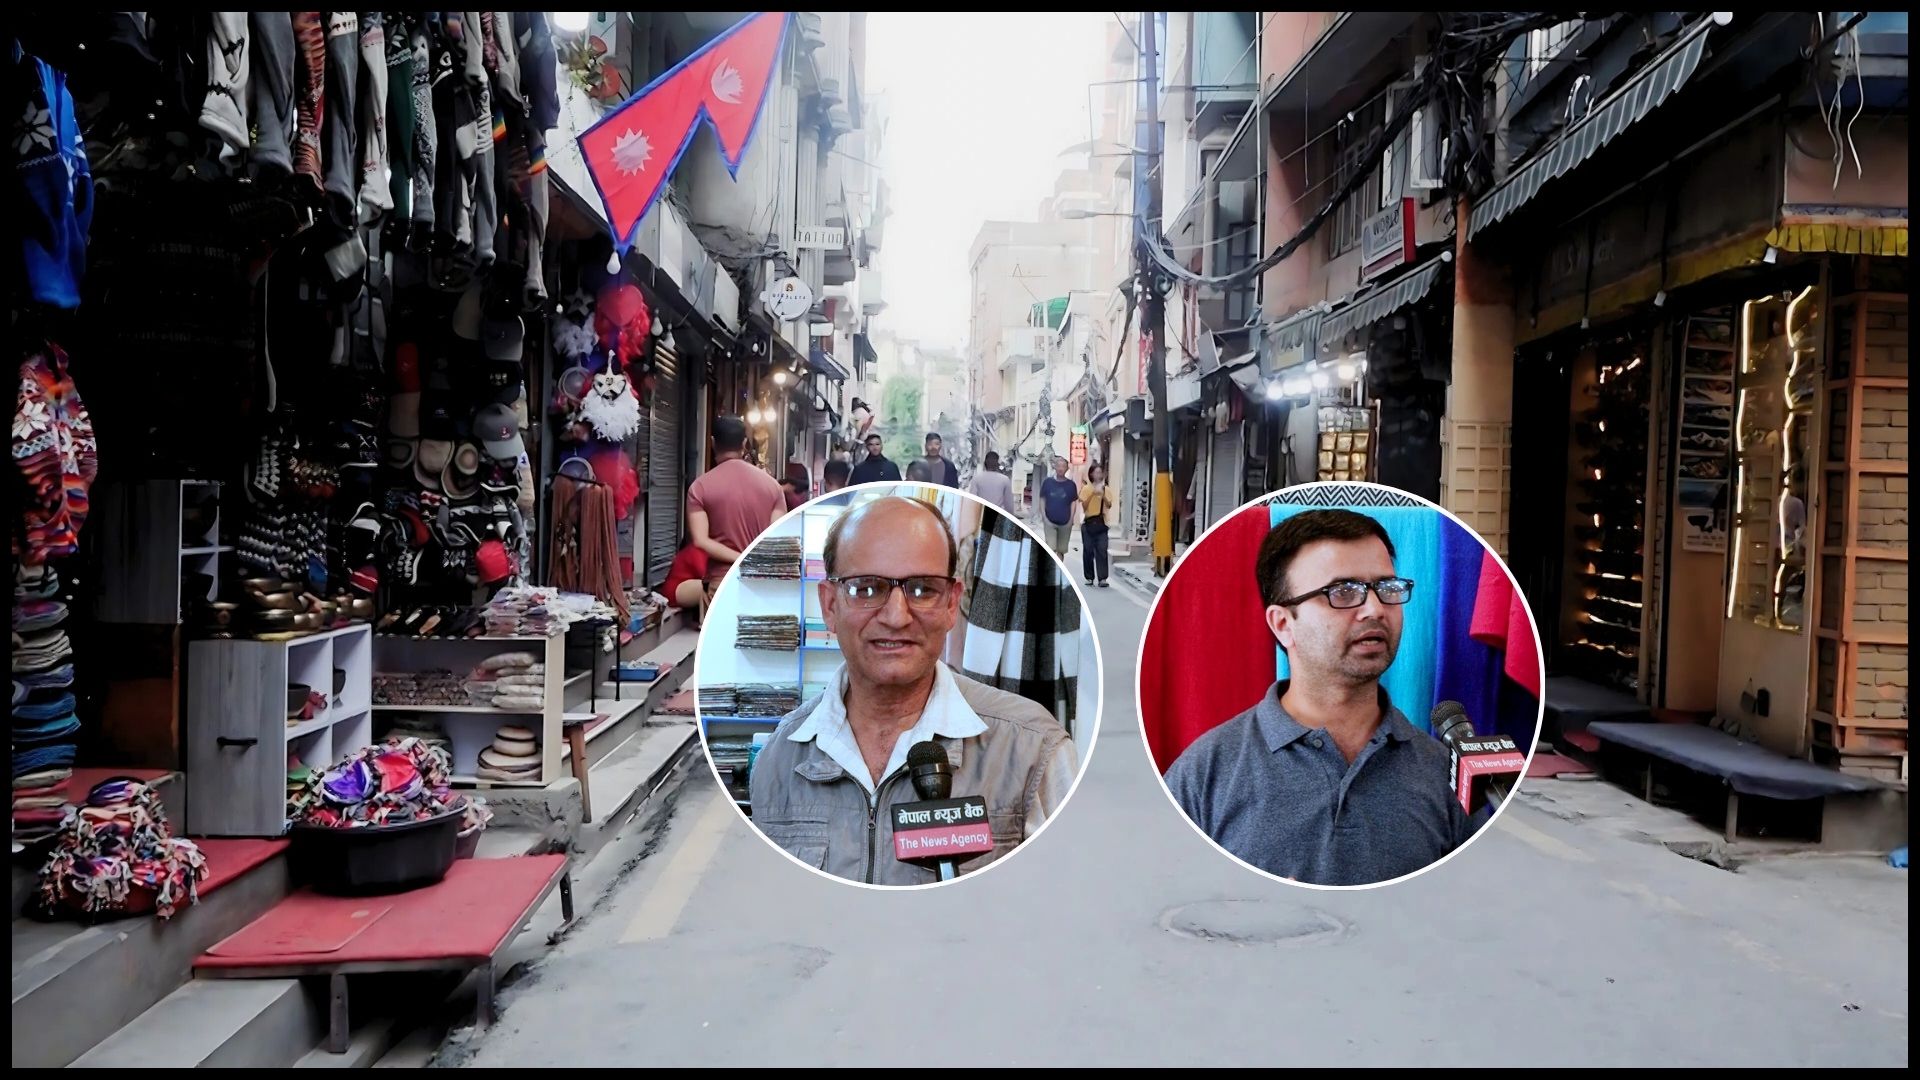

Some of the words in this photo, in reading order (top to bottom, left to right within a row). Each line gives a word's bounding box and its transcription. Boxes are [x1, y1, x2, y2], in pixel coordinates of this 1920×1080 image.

[1469, 760, 1484, 769] The
[1483, 759, 1502, 768] News
[898, 810, 930, 823] नेपाल
[934, 808, 961, 823] न्यूज
[900, 839, 918, 849] The
[921, 837, 948, 847] News
[951, 834, 988, 846] Agency
